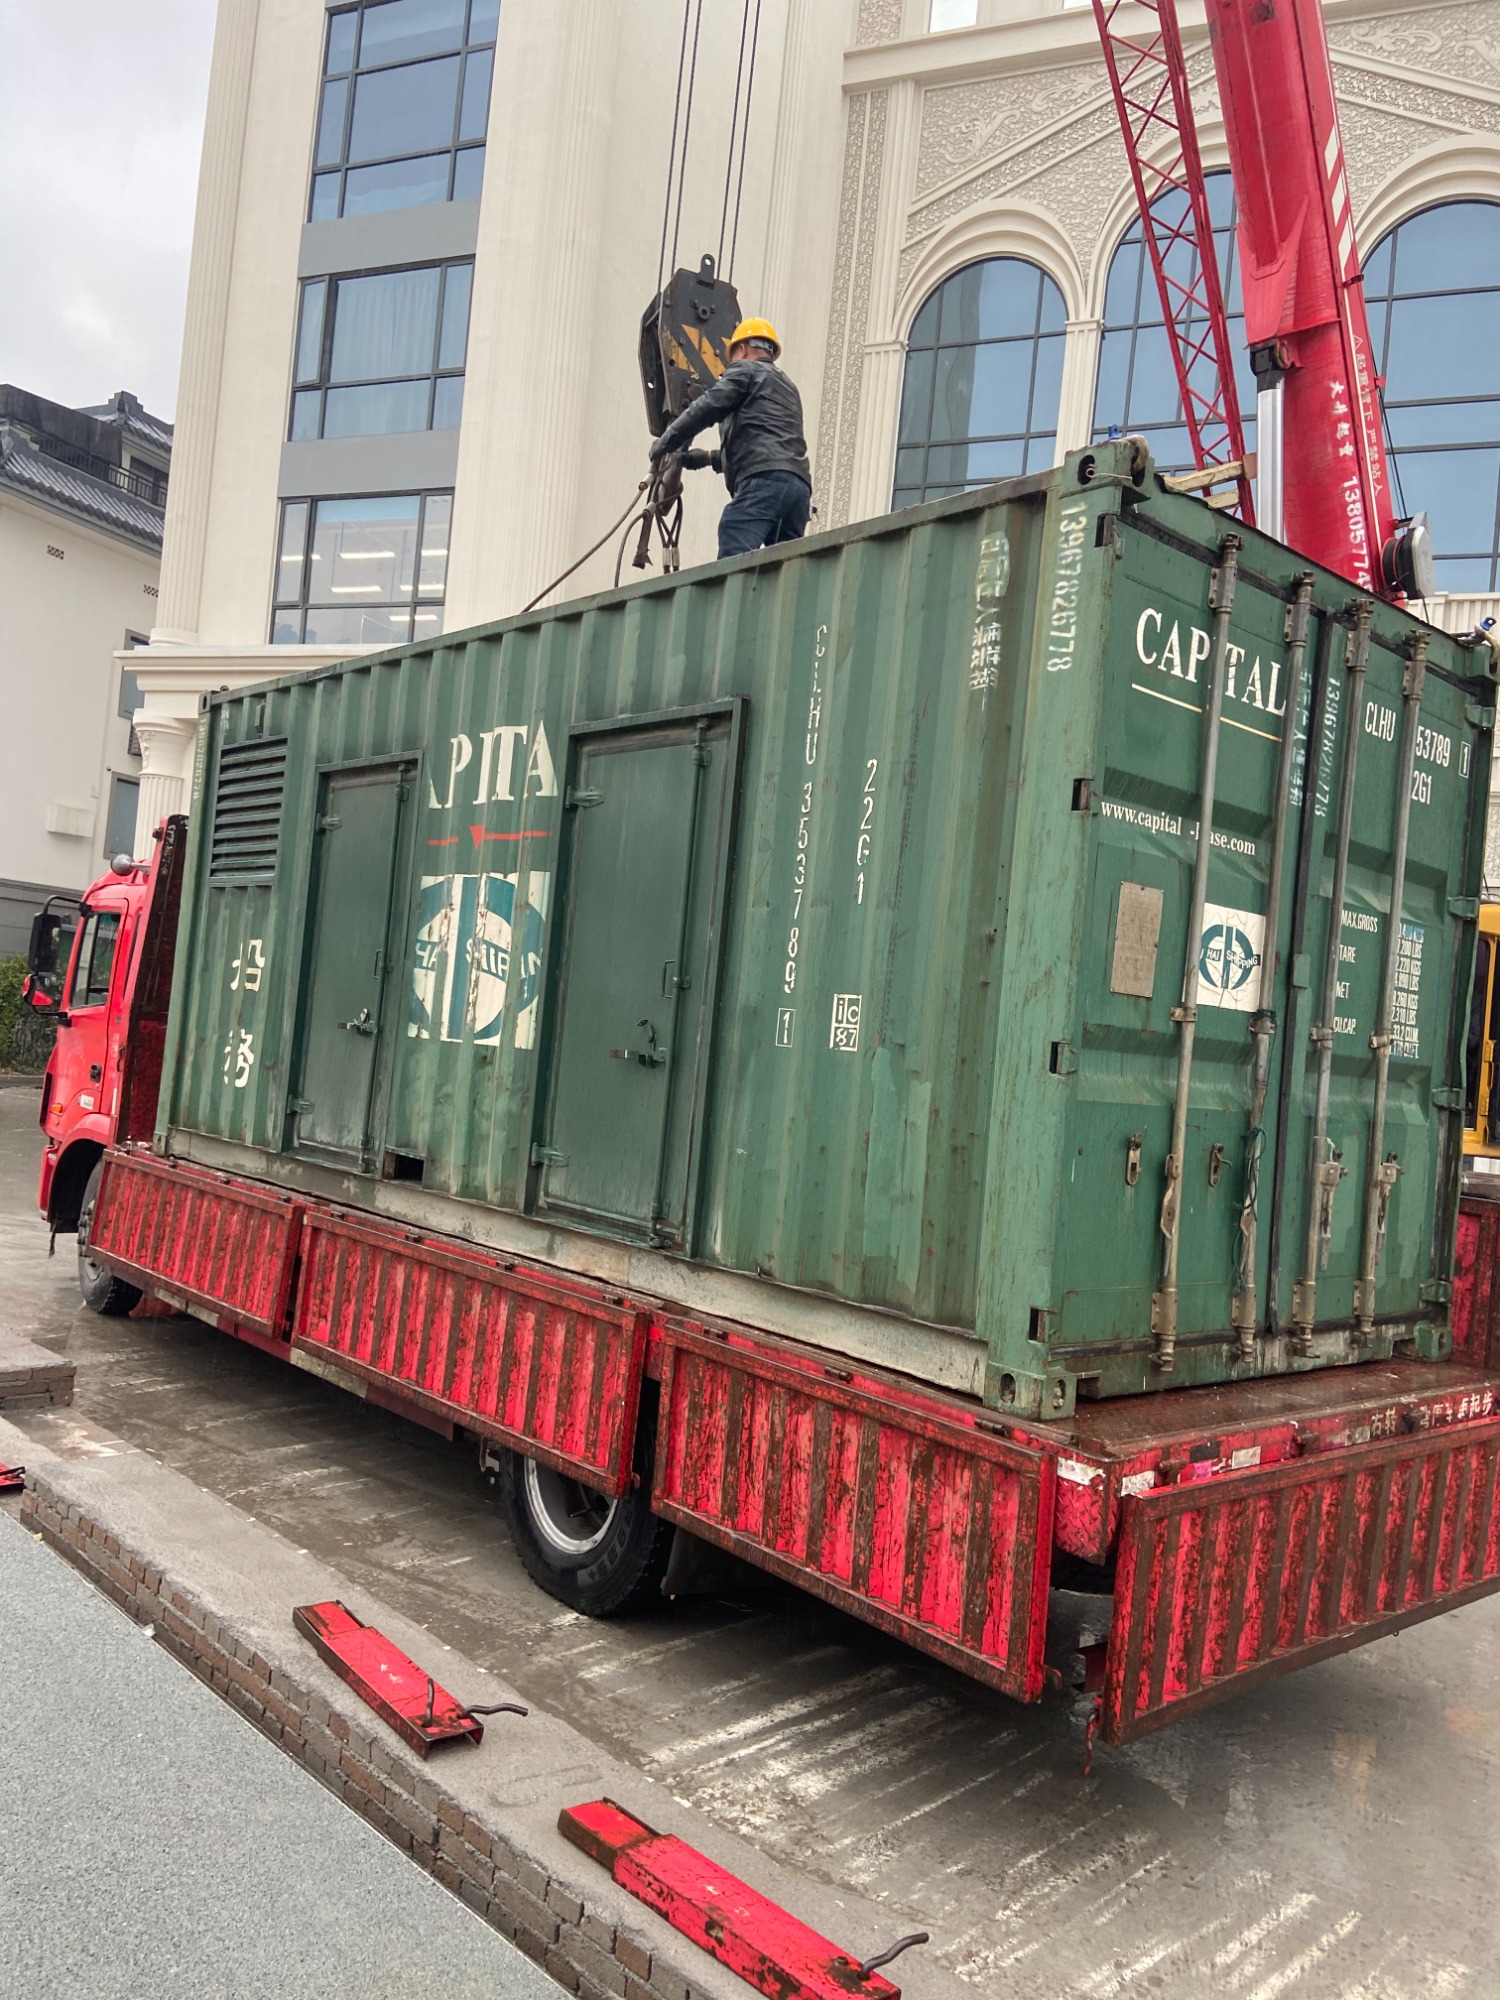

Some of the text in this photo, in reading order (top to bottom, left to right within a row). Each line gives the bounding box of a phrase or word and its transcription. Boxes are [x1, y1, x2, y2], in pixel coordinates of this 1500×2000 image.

[1366, 428, 1383, 497] 严禁站人
[1047, 501, 1087, 672] 13967826778
[1136, 608, 1286, 716] CAPTAL
[1365, 702, 1396, 741] CLHU
[857, 758, 878, 904] 22G1
[1206, 947, 1220, 961] HAI
[1226, 950, 1258, 969] SHIPPING
[1339, 944, 1356, 963] TARE
[1336, 981, 1350, 999] NET
[835, 1028, 857, 1047] 87
